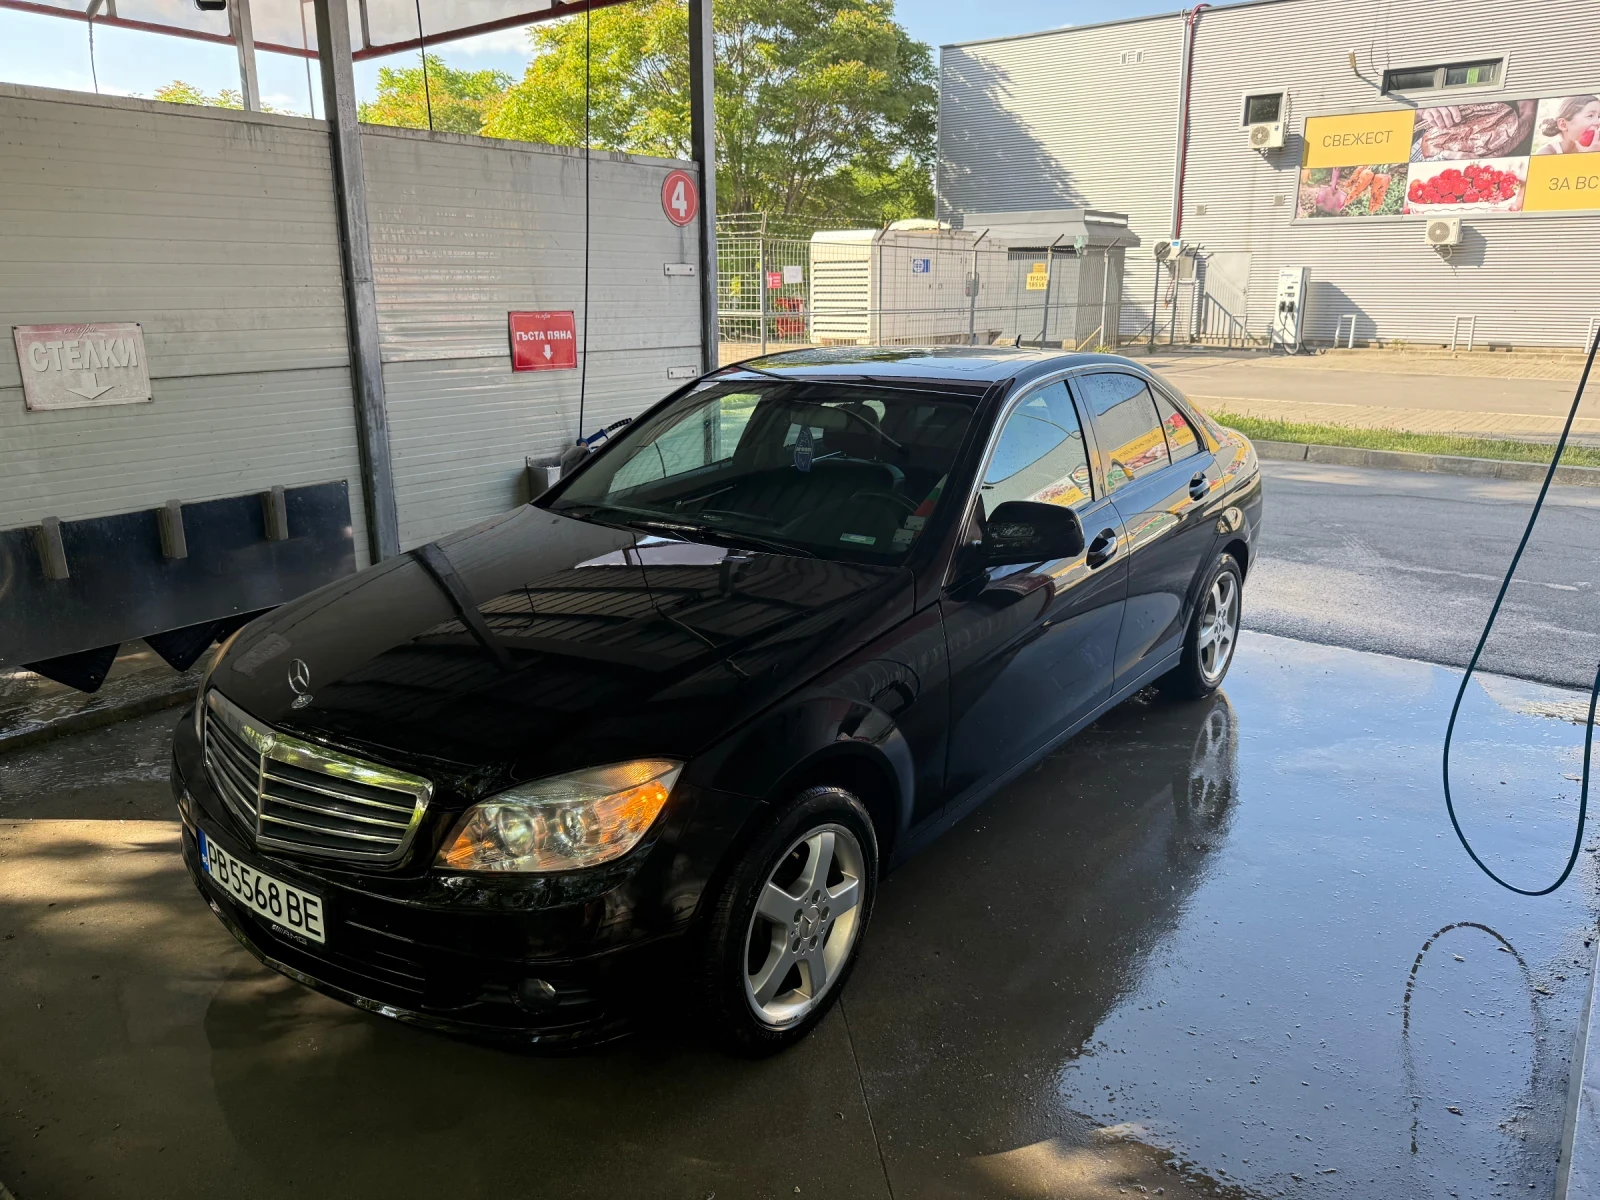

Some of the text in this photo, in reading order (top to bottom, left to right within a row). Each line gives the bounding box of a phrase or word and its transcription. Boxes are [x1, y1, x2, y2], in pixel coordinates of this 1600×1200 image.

[1322, 130, 1394, 148] СВЕЖЕСТ
[1548, 175, 1600, 191] ЗА ВС
[671, 181, 688, 217] 4
[516, 330, 573, 341] ГЪСТА ПЯНА
[27, 338, 139, 373] СТЕЛКИ
